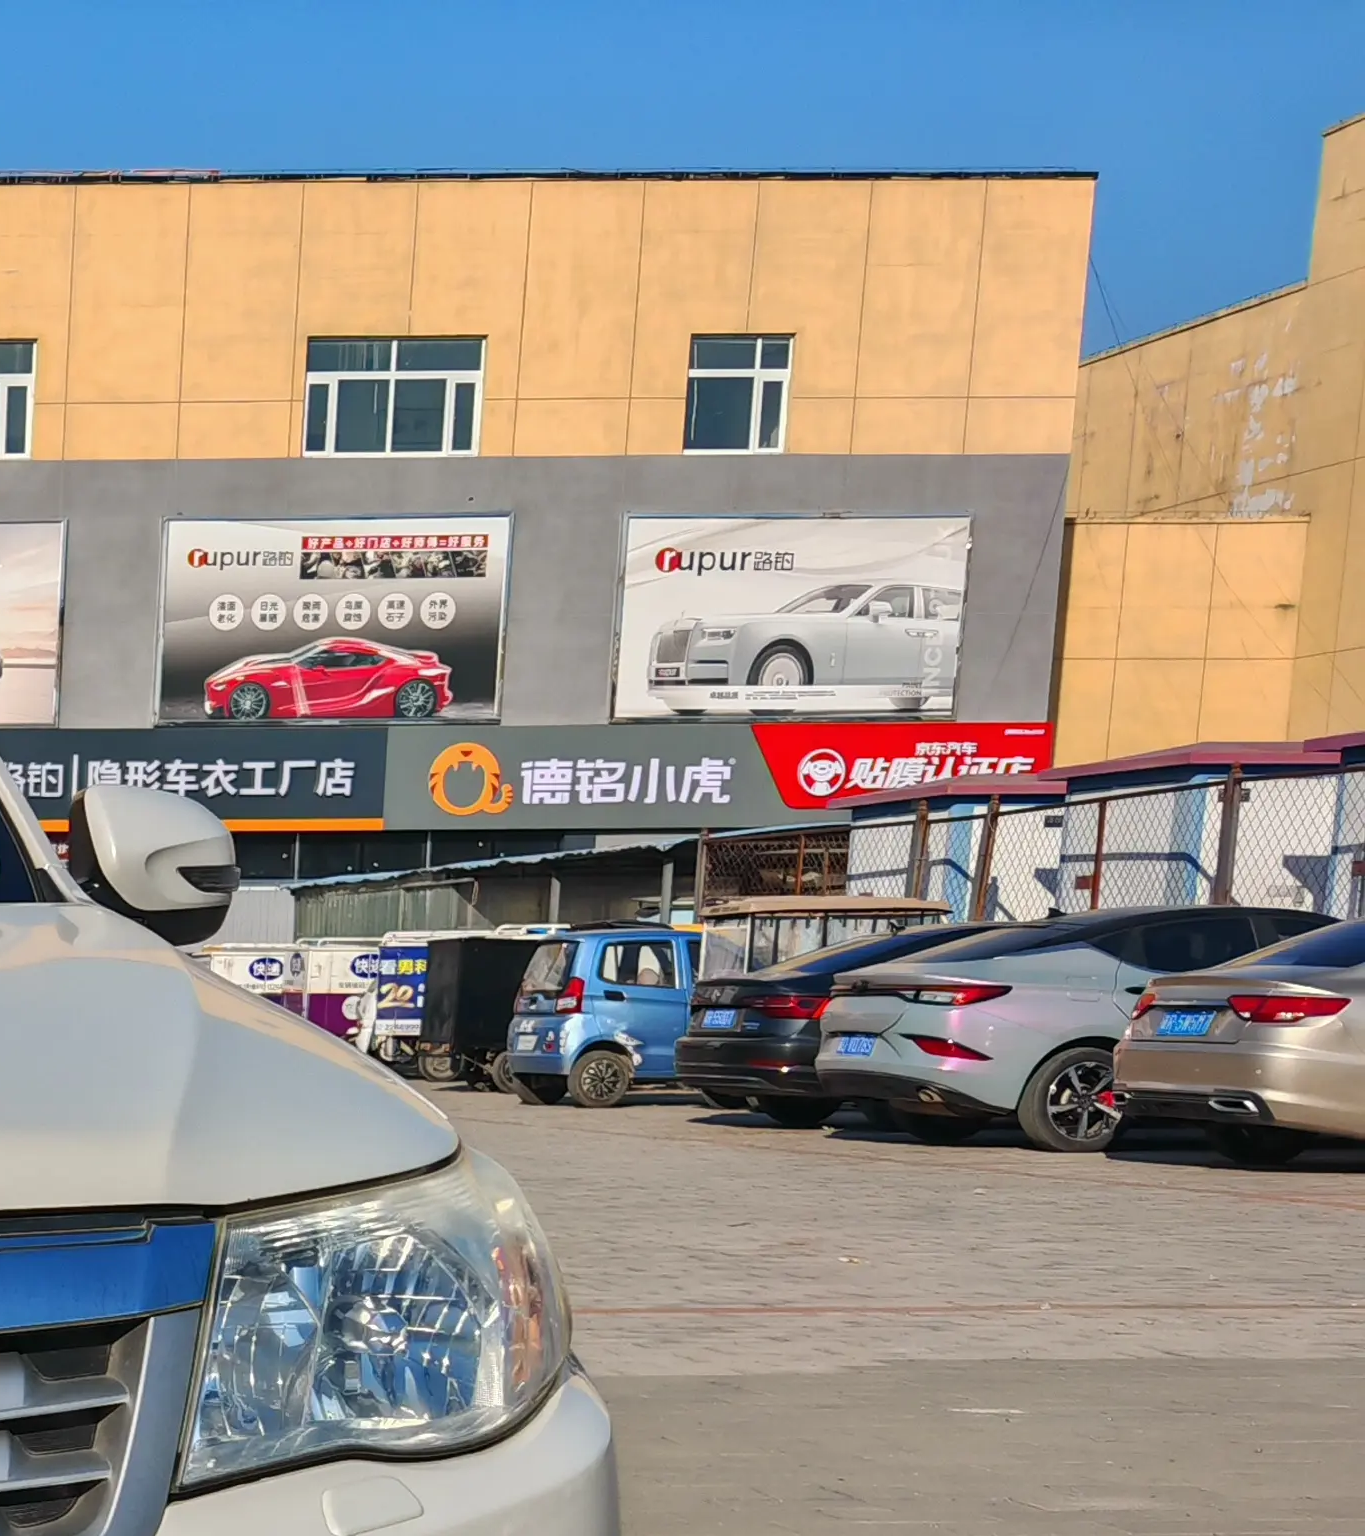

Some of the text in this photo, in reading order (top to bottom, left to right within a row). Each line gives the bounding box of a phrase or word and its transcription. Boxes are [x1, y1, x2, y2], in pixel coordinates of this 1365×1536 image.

[190, 549, 260, 570] rupur
[659, 548, 752, 576] rupur
[521, 757, 732, 804] 德铭小虎
